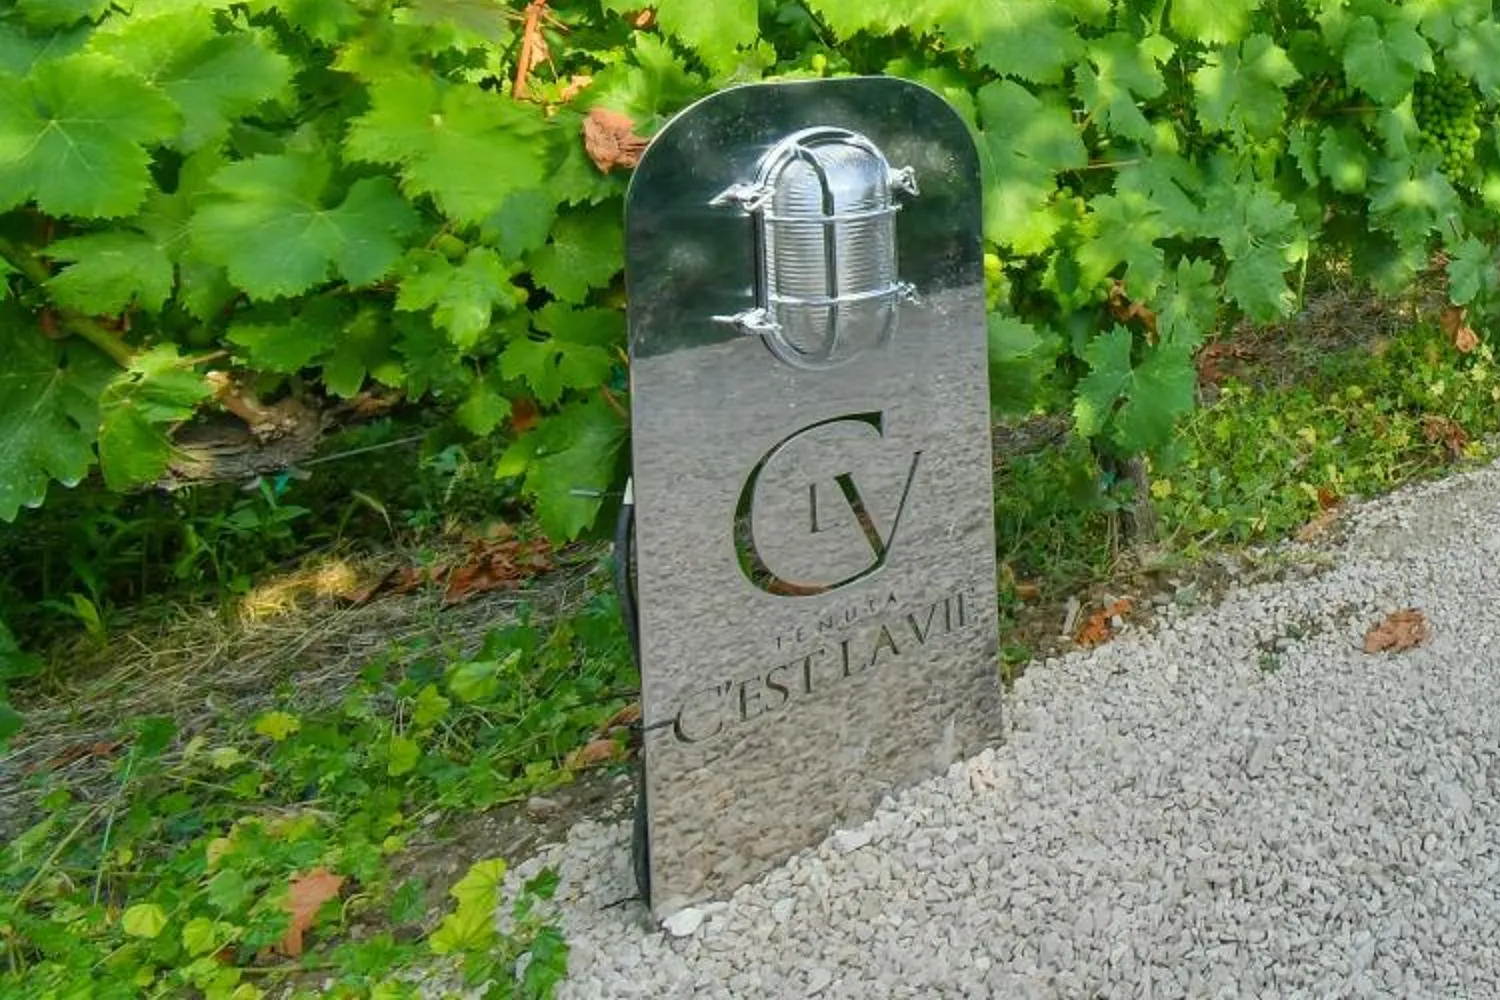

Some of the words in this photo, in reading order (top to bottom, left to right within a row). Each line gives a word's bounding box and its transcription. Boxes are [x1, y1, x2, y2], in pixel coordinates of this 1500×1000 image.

[673, 648, 826, 743] C'EST
[840, 624, 901, 678] LA
[906, 587, 977, 645] VIE
[773, 592, 898, 650] TENUTA
